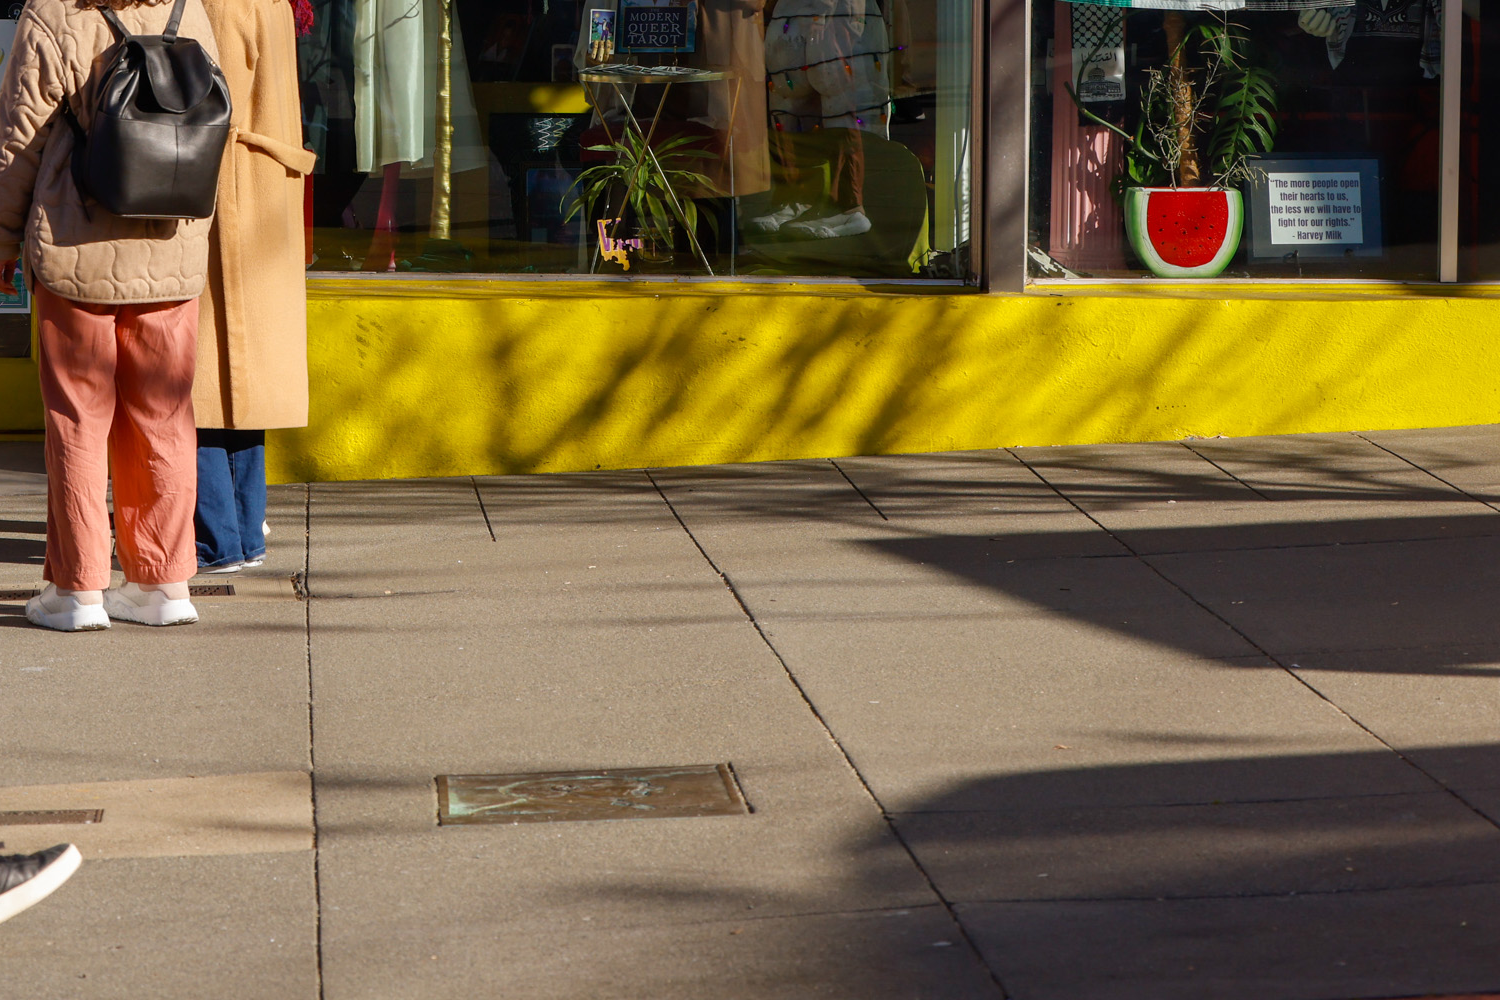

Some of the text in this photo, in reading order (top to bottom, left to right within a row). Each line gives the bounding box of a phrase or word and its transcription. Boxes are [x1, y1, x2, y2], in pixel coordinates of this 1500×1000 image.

[630, 12, 680, 23] MODERN
[628, 23, 684, 36] QUEER
[628, 34, 680, 47] TAROT
[1290, 180, 1310, 188] more
[1312, 179, 1338, 189] people
[1340, 180, 1359, 189] open
[1280, 192, 1348, 201] their hearts to us,
[1271, 205, 1283, 214] the
[1285, 205, 1301, 214] less
[1317, 205, 1331, 213] will
[1333, 205, 1351, 213] have
[1353, 205, 1361, 213] to
[1278, 218, 1296, 227] fight
[1298, 218, 1308, 226] for
[1297, 231, 1323, 240] Harvey
[1325, 231, 1342, 239] Milk
